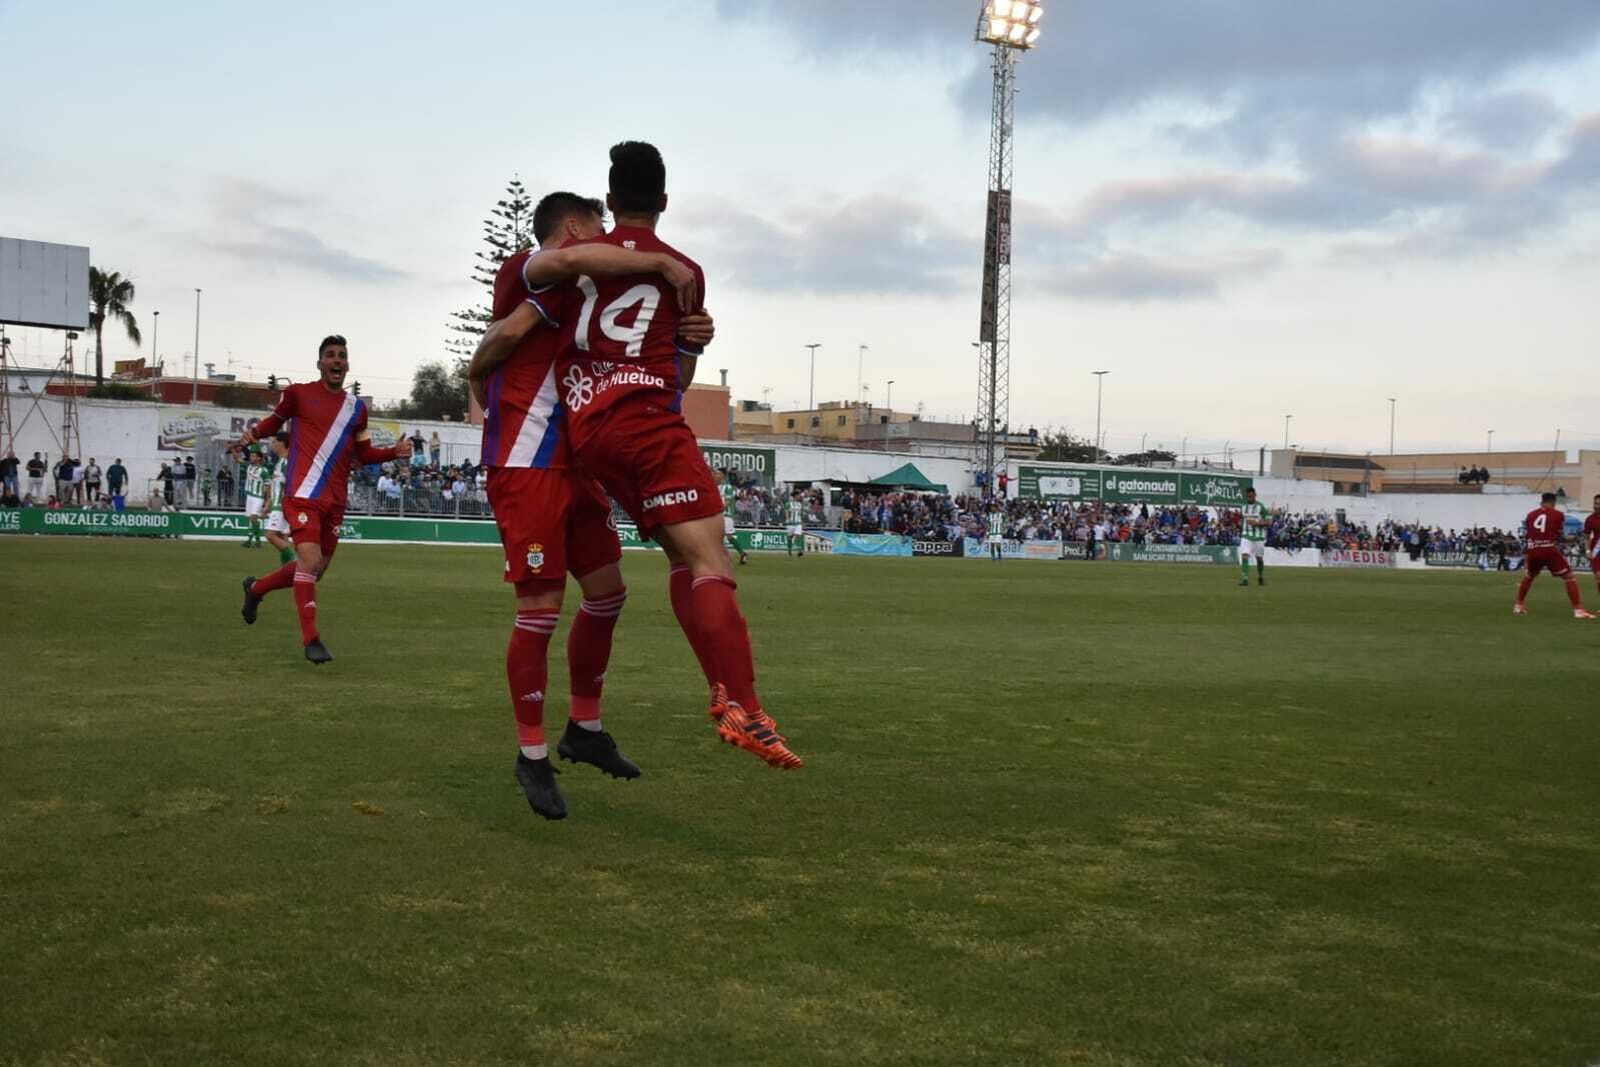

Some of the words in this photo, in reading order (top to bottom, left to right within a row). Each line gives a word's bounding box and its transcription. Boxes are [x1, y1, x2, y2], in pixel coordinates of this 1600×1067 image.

[576, 274, 661, 357] 14
[703, 451, 766, 473] ABORIDO
[1106, 476, 1117, 490] el
[1118, 478, 1177, 494] gatonauta
[643, 489, 699, 511] OMERO
[44, 512, 109, 526] GONZALEZ
[111, 514, 169, 528] SABORIDO
[1533, 514, 1547, 533] 4
